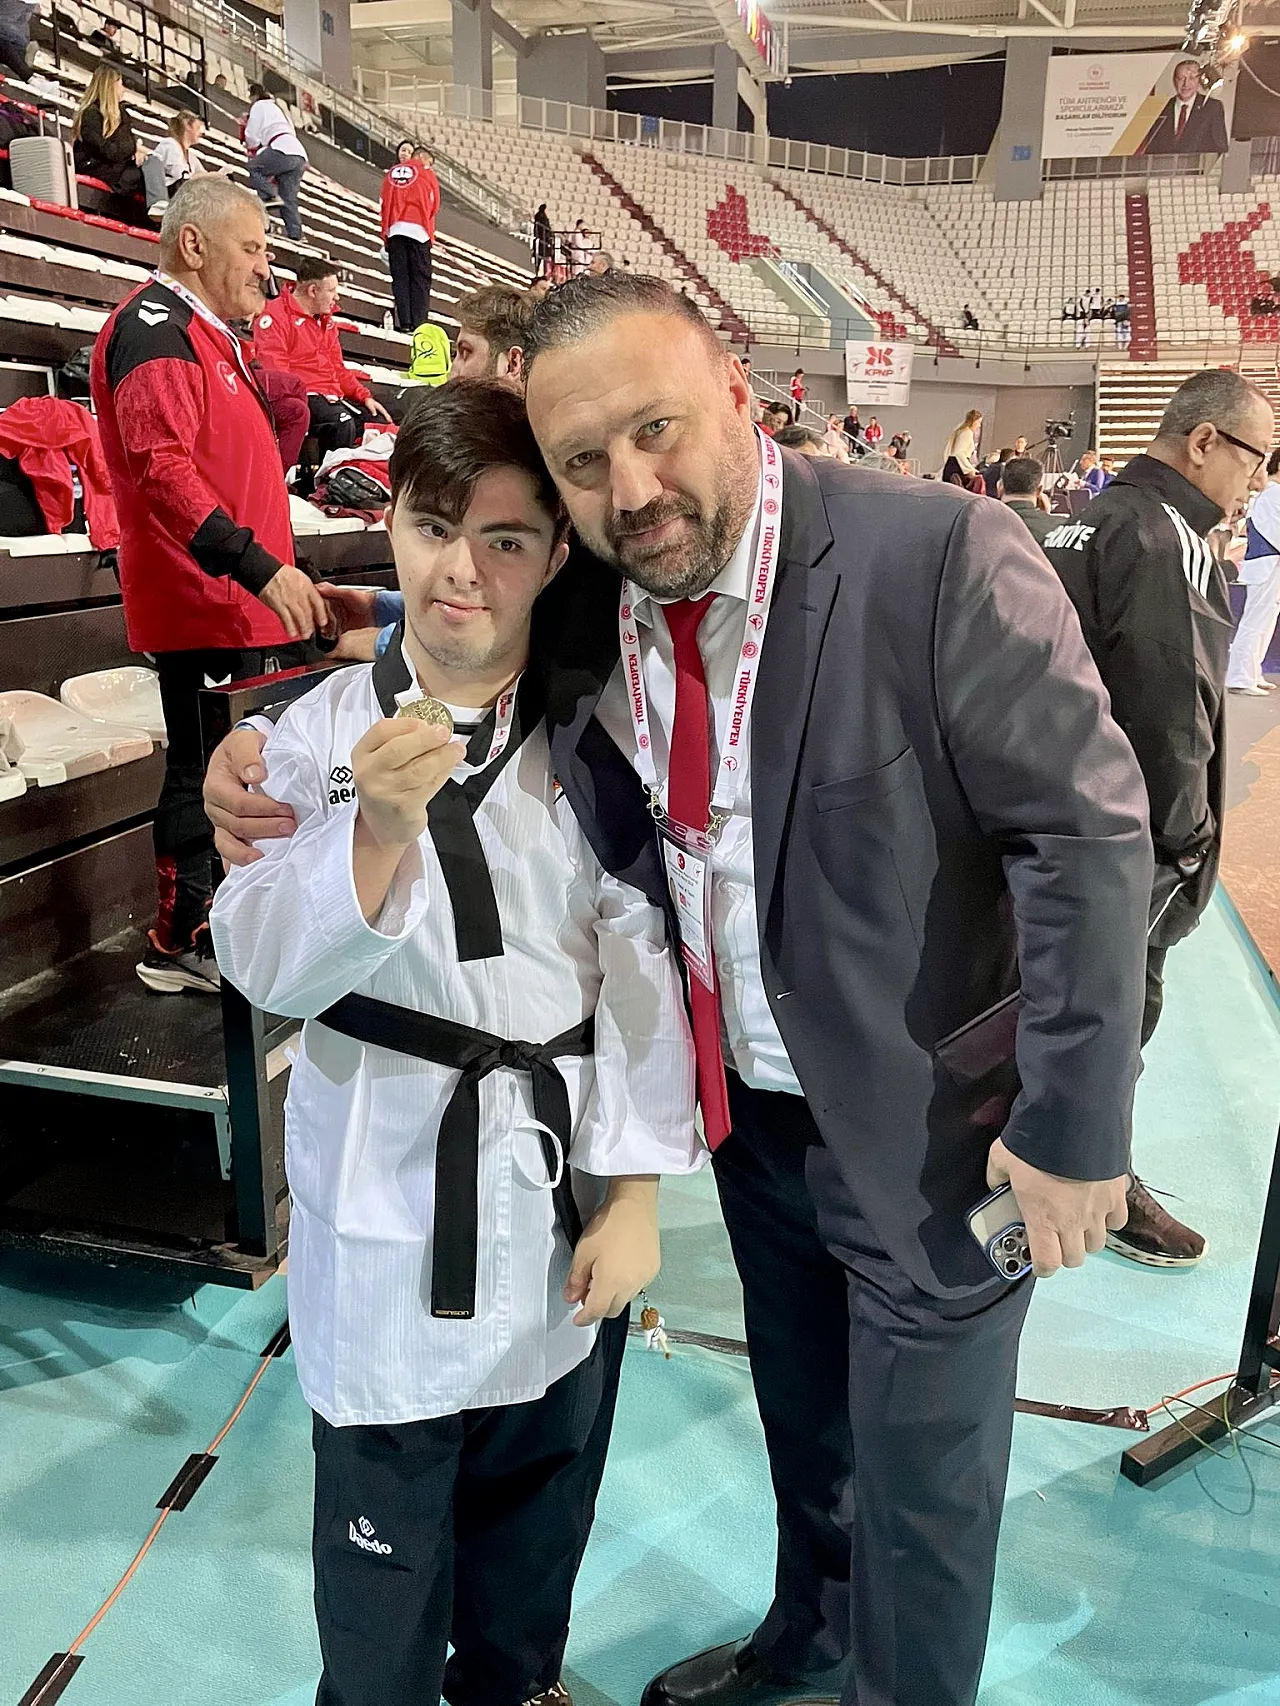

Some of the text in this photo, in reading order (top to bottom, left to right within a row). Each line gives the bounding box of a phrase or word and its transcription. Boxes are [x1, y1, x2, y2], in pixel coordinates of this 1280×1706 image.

[864, 368, 894, 376] KPNP
[754, 525, 775, 604] TÜRKİYEOPEN
[628, 653, 645, 725] TÜRKİYEOPEN
[729, 669, 751, 746] TÜRKİYEOPEN
[348, 1520, 393, 1554] Daedo
